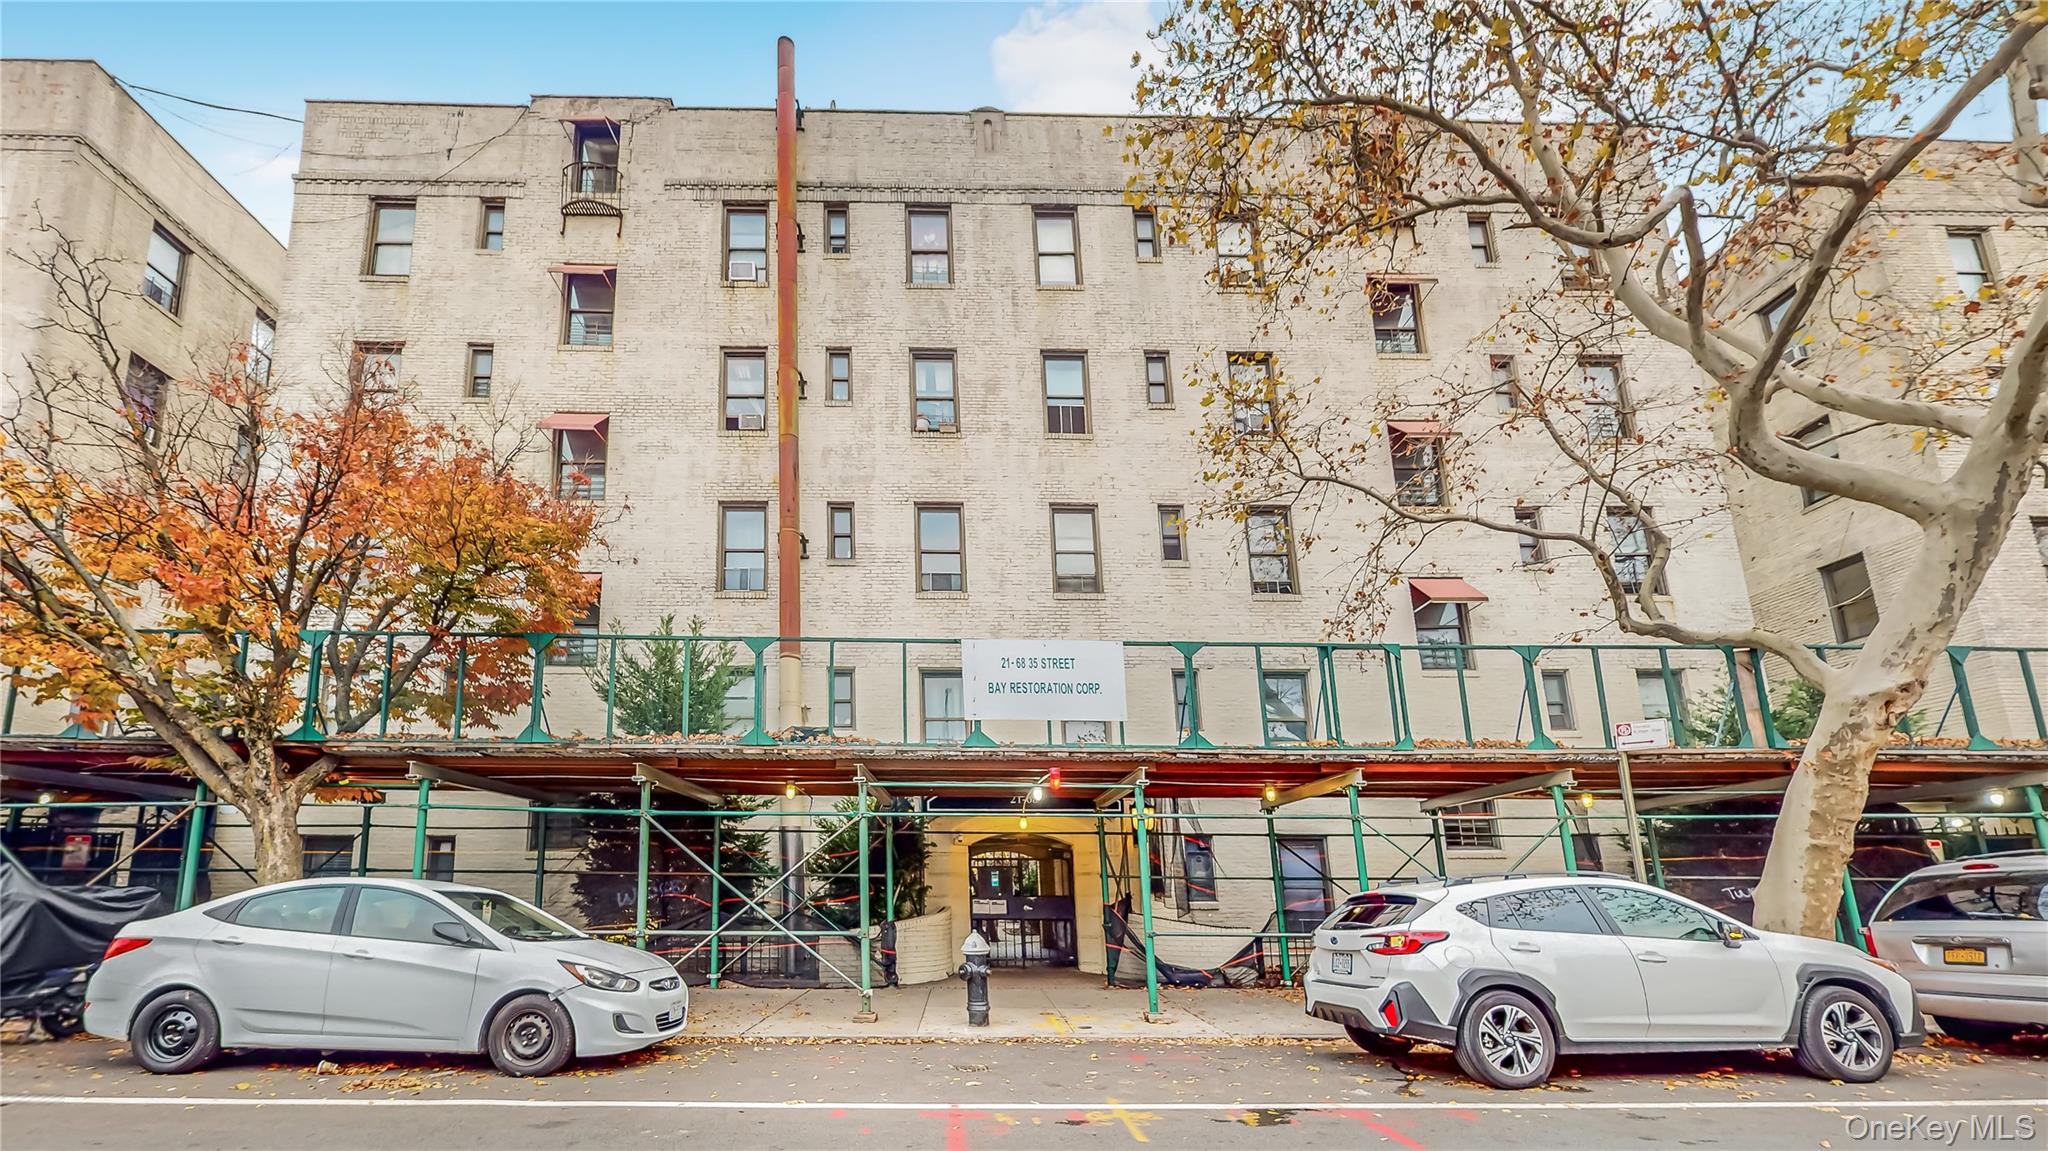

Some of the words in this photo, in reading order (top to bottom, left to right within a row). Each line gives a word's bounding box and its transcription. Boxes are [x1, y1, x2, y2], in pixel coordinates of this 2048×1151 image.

[1028, 657, 1038, 669] 35
[1040, 657, 1076, 670] STREET
[988, 682, 1007, 694] BAY
[1009, 682, 1074, 695] RESTORATION
[1076, 682, 1103, 695] CORP.
